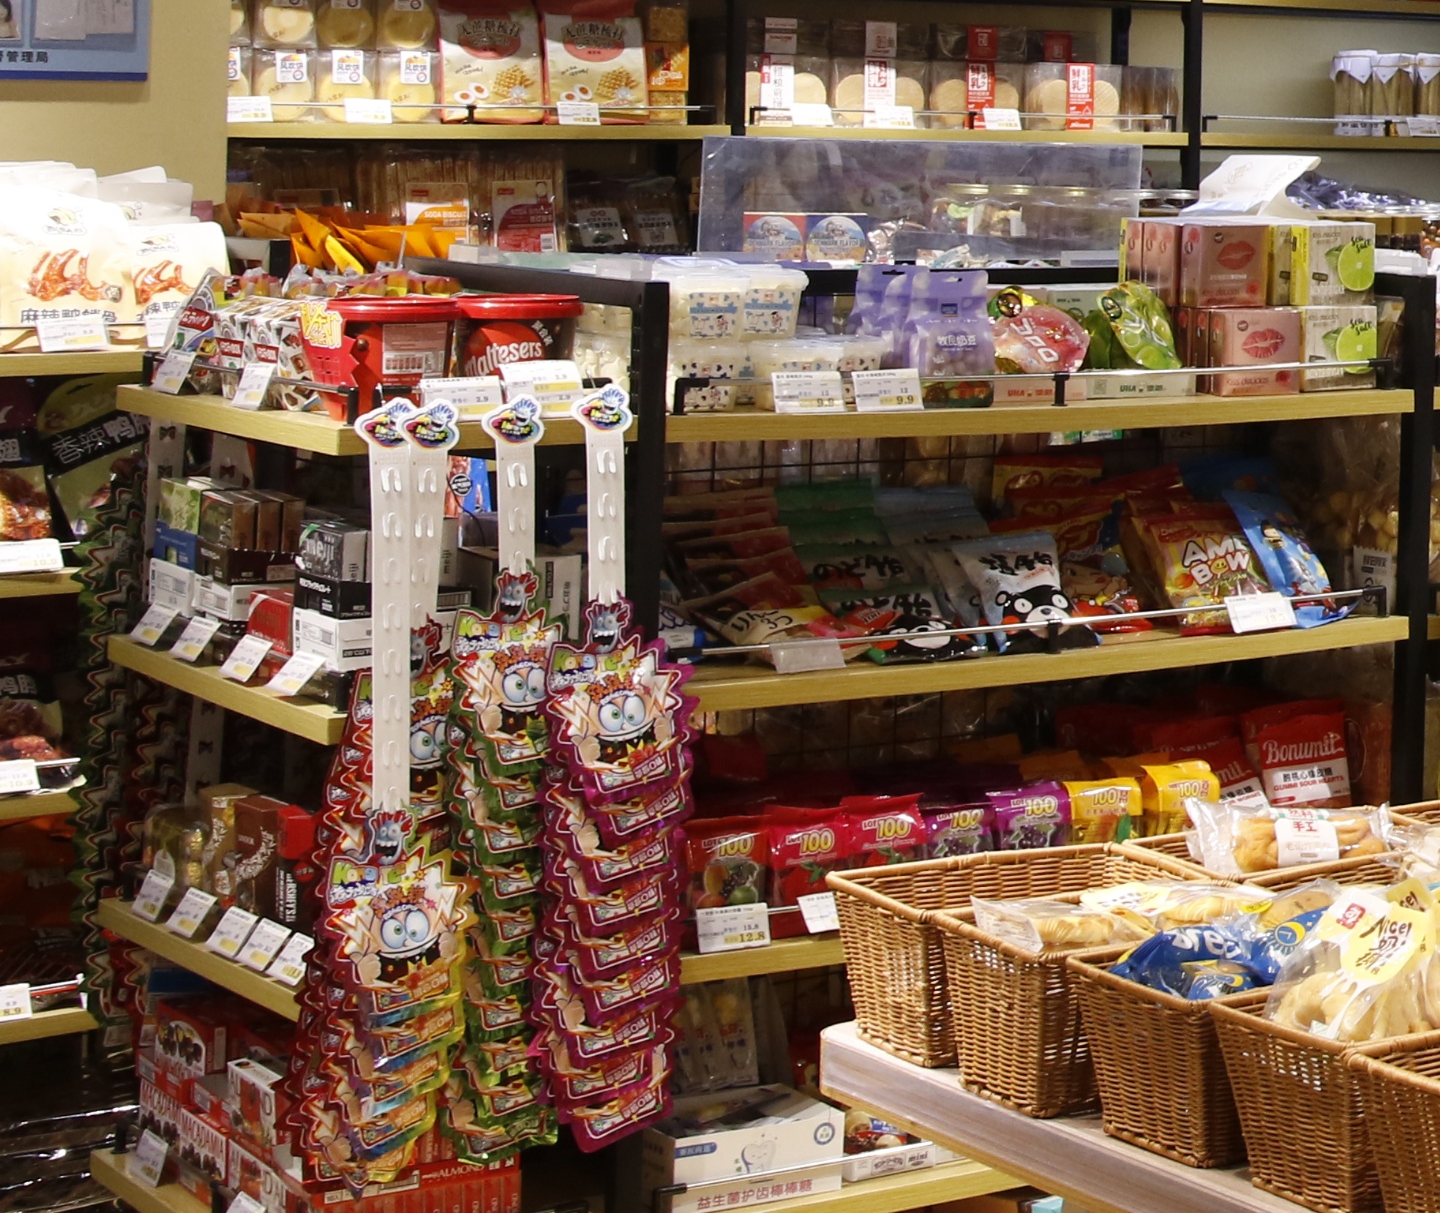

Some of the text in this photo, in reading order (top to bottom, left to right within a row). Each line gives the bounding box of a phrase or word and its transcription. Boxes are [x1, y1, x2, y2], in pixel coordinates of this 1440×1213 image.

[0, 50, 48, 64] 管理局
[1092, 787, 1118, 807] 100
[1178, 779, 1201, 798] 100
[1025, 795, 1058, 817] 100
[876, 814, 912, 839] 100
[950, 807, 983, 829] 100
[1292, 819, 1318, 833] 手工
[717, 832, 754, 857] 100
[800, 829, 835, 853] 100
[738, 931, 766, 943] 12.8
[438, 1164, 486, 1178] ALMOND
[696, 1179, 814, 1211] 益生菌护齿棒棒糖
